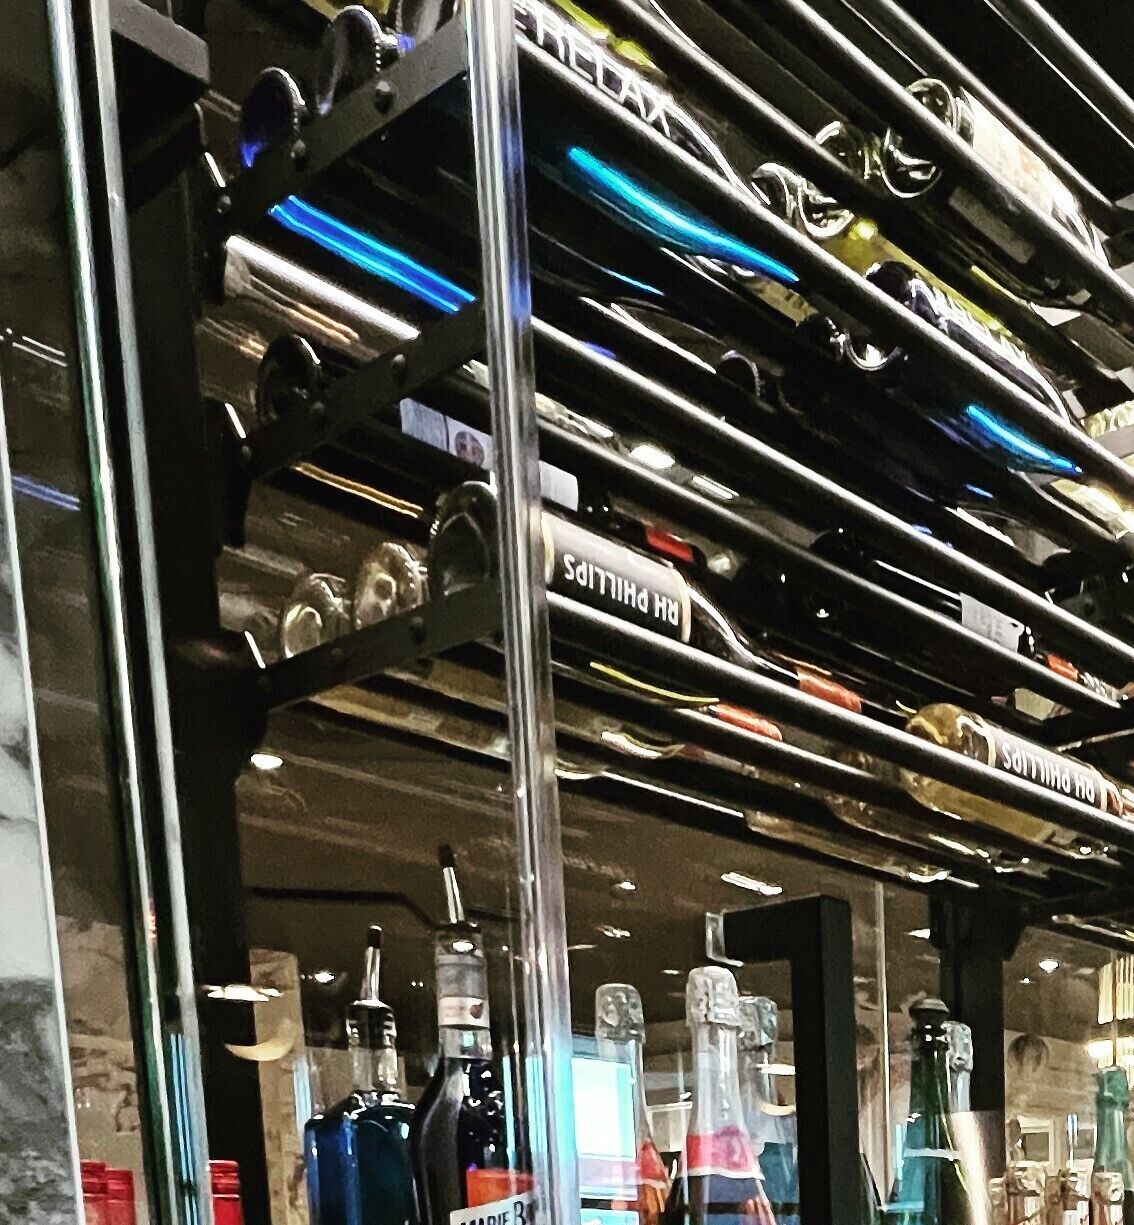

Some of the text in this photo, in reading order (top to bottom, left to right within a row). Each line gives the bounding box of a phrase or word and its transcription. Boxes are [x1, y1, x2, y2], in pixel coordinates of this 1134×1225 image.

[563, 553, 679, 626] RH PHILLIPS
[1001, 741, 1071, 794] PHILLIPS
